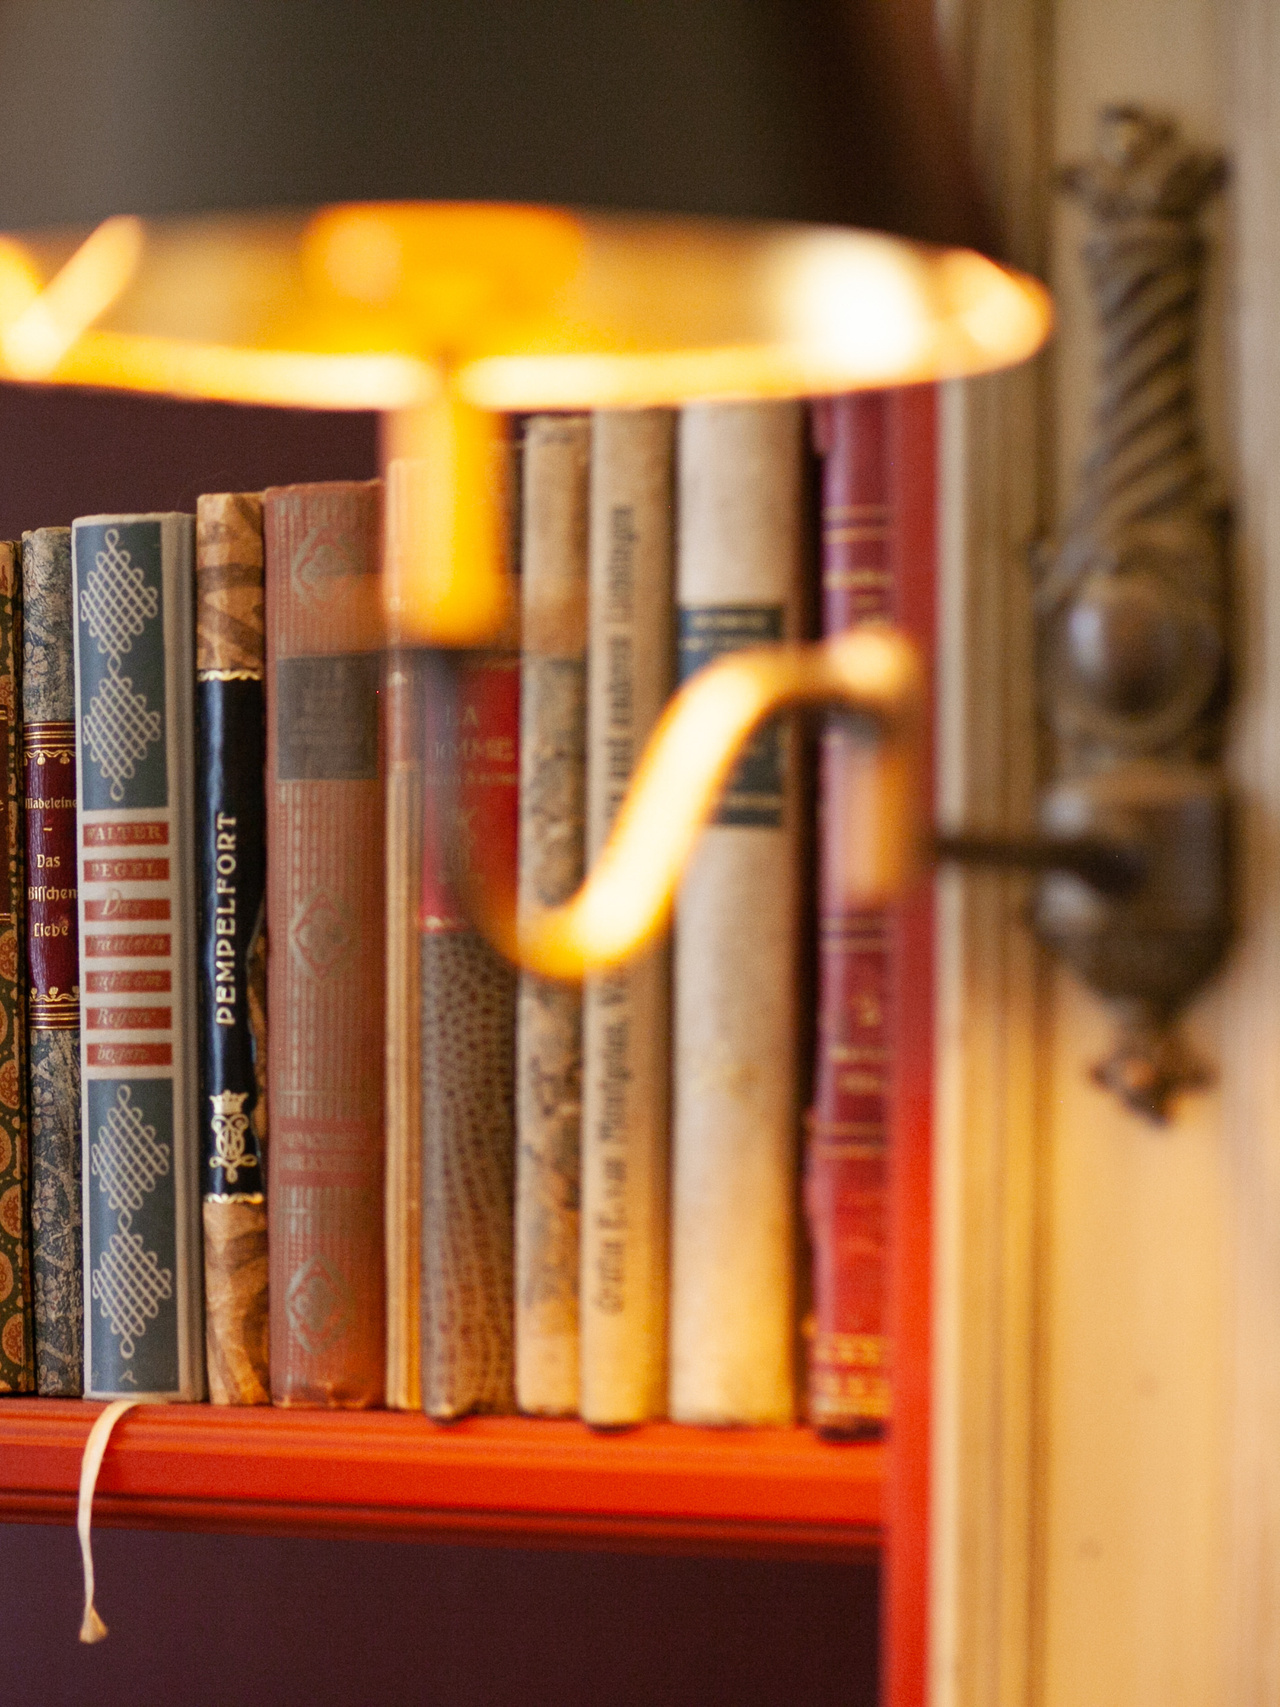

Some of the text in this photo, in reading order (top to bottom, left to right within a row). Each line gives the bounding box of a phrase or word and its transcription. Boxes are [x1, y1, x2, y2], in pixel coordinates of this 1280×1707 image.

[87, 824, 162, 842] WALTER
[36, 853, 61, 869] Das
[215, 811, 238, 1025] PEMPELFORT
[33, 922, 69, 938] Liebe
